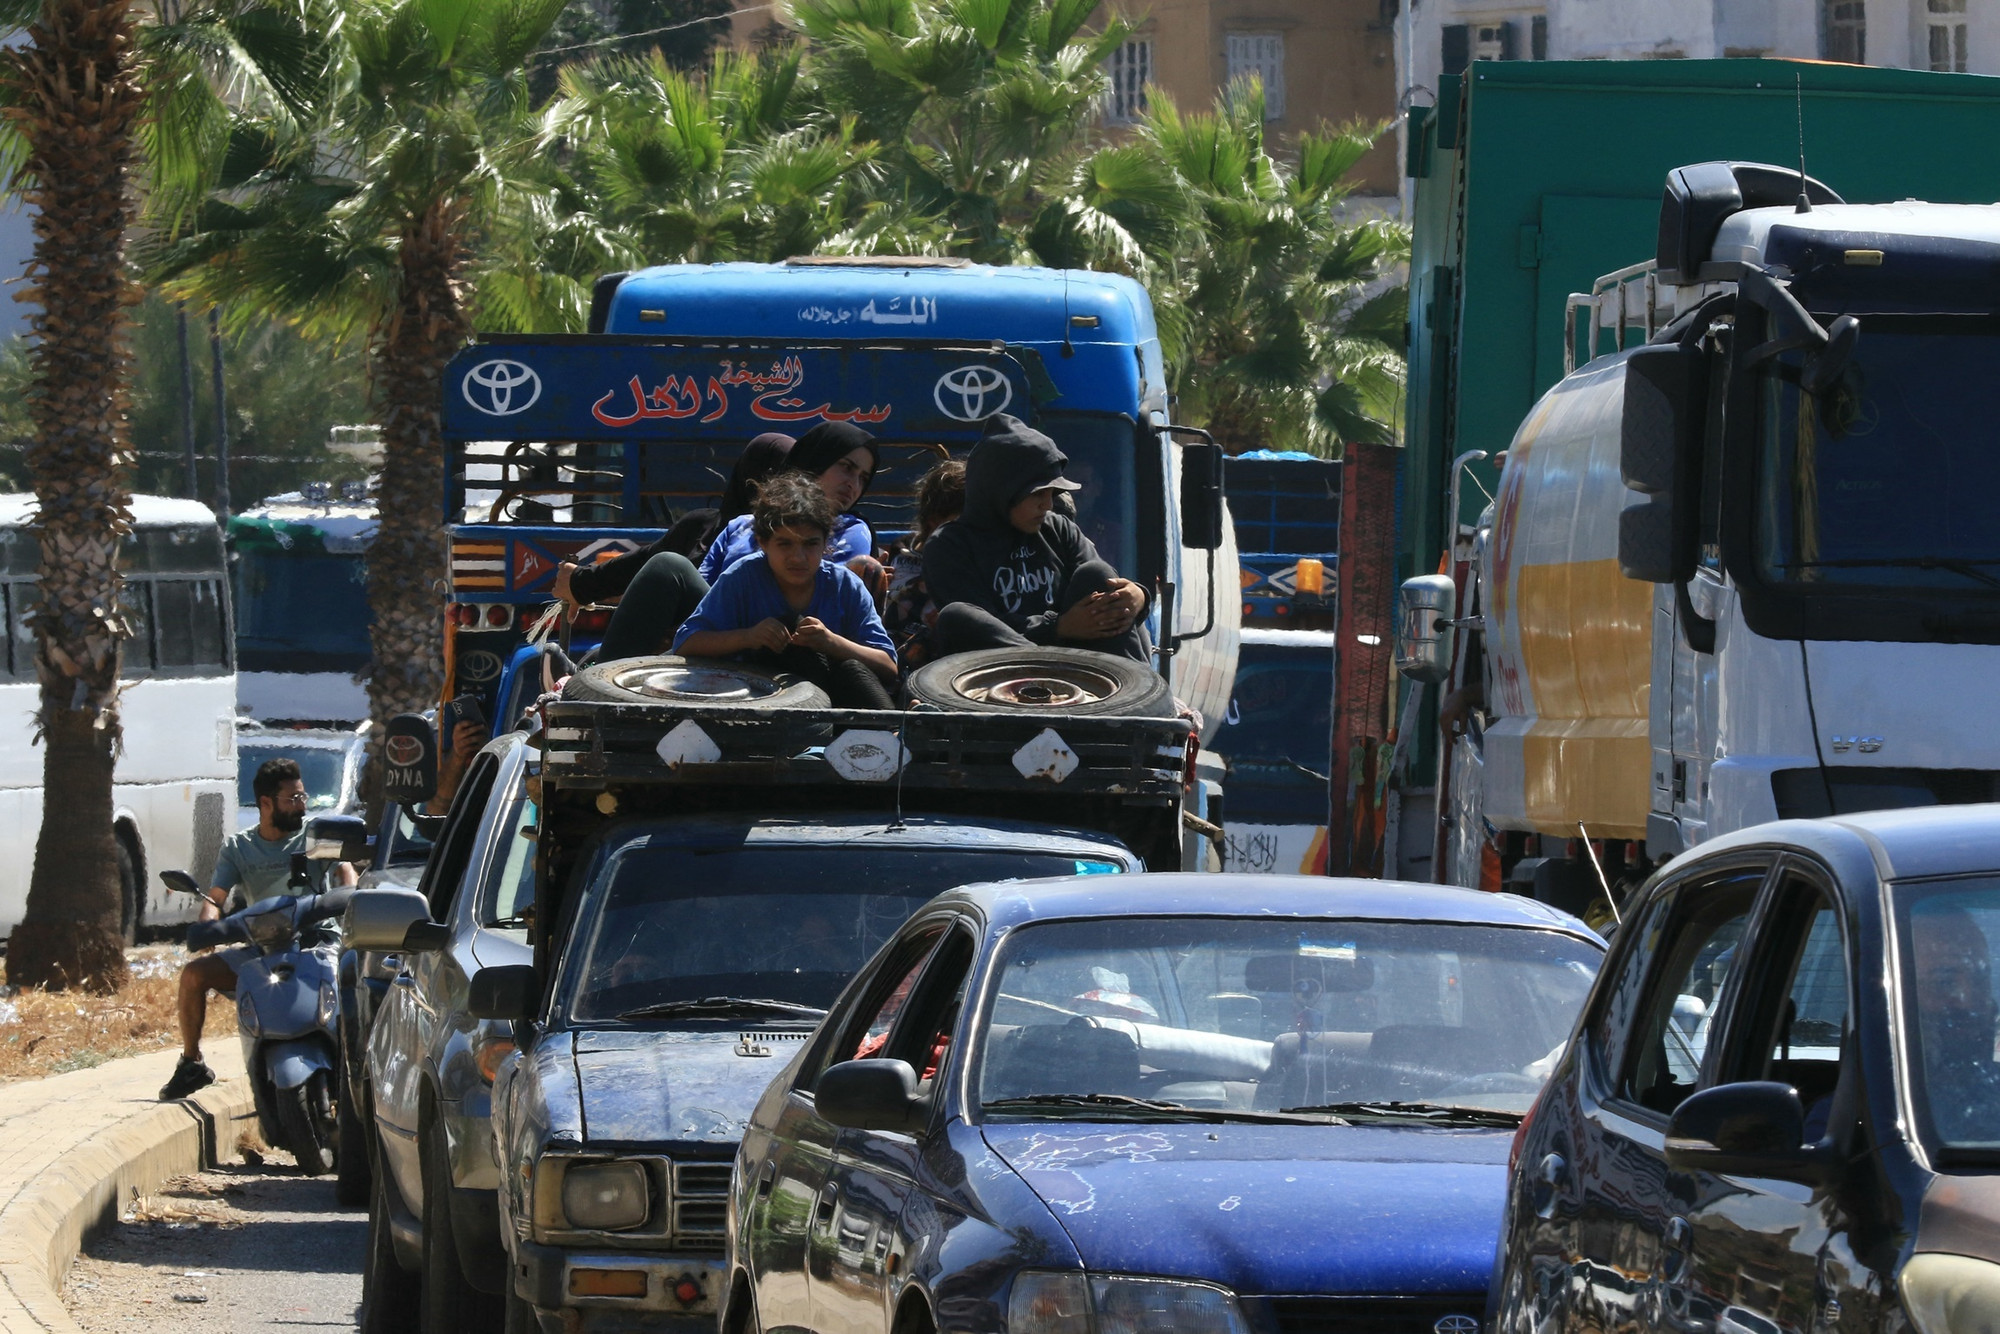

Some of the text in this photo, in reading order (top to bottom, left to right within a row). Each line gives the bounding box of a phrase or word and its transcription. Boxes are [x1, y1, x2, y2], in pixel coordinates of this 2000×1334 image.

[719, 355, 803, 391] الشيخة
[592, 374, 892, 428] ست الكل
[993, 561, 1055, 614] Baby
[1832, 735, 1884, 753] V6
[386, 768, 424, 788] DYNA
